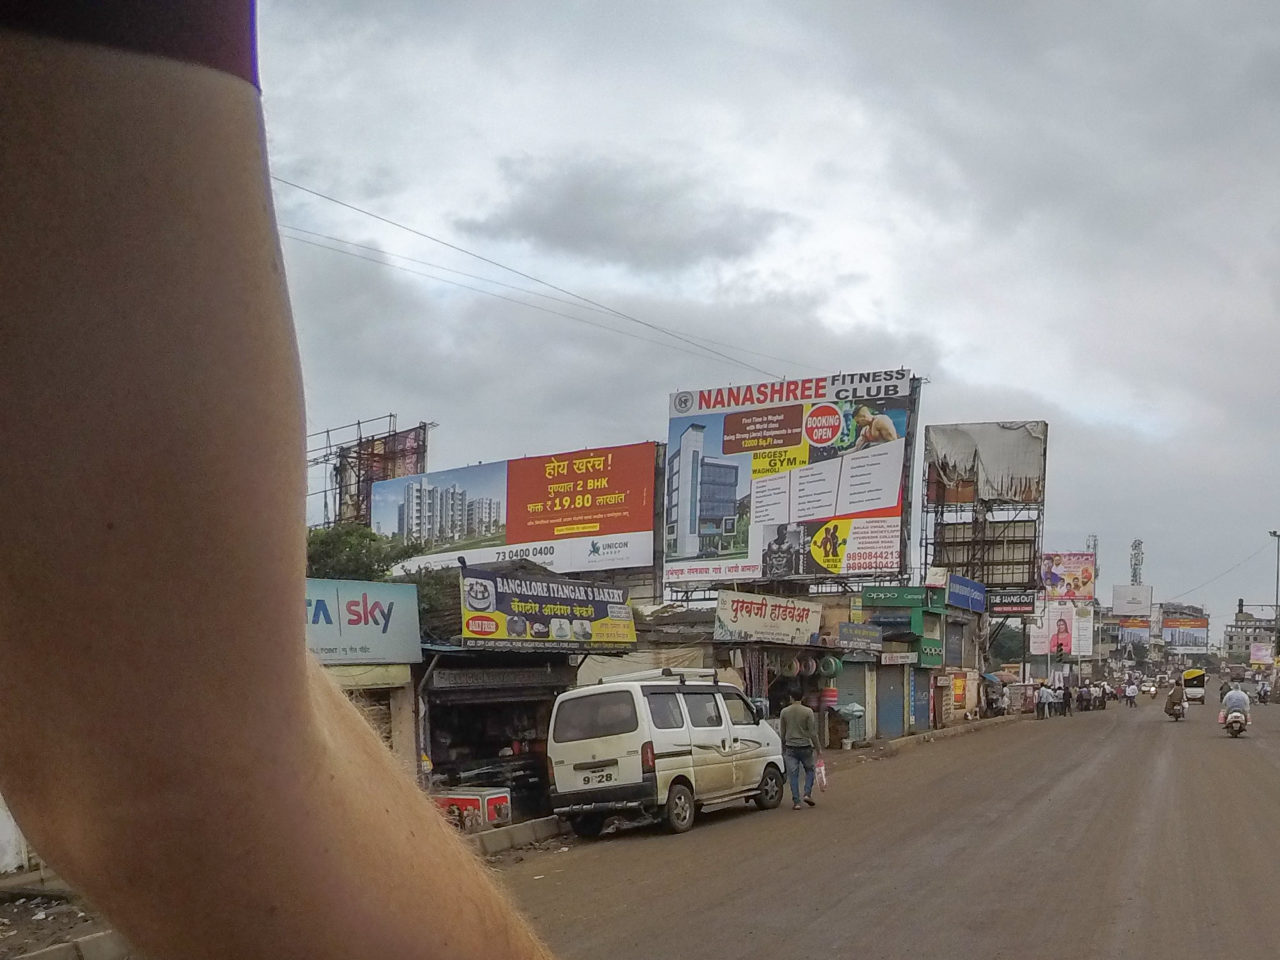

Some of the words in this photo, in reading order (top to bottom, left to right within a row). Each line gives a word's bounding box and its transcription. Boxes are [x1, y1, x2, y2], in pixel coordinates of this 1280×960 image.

[698, 377, 828, 410] NANASHREE
[831, 369, 906, 386] FITNESS
[834, 383, 900, 401] CLUB
[807, 414, 840, 428] BOOKING
[813, 427, 833, 441] OPEN
[752, 450, 789, 460] BIGGEST
[768, 456, 797, 468] GYM
[545, 457, 568, 479] होय
[752, 467, 780, 475] WAGHOLI
[548, 482, 574, 498] पुण्यात
[577, 480, 584, 491] 2
[587, 477, 609, 491] BHK
[602, 541, 629, 551] UNICON
[495, 551, 507, 561] 73
[508, 548, 530, 560] 0400
[532, 546, 555, 558] 0400
[846, 550, 901, 562] 9890844213
[496, 577, 549, 597] BANGALORE
[594, 588, 623, 602] BAKERY
[867, 592, 898, 600] oppo
[346, 592, 395, 634] sky
[923, 646, 944, 656] oppo
